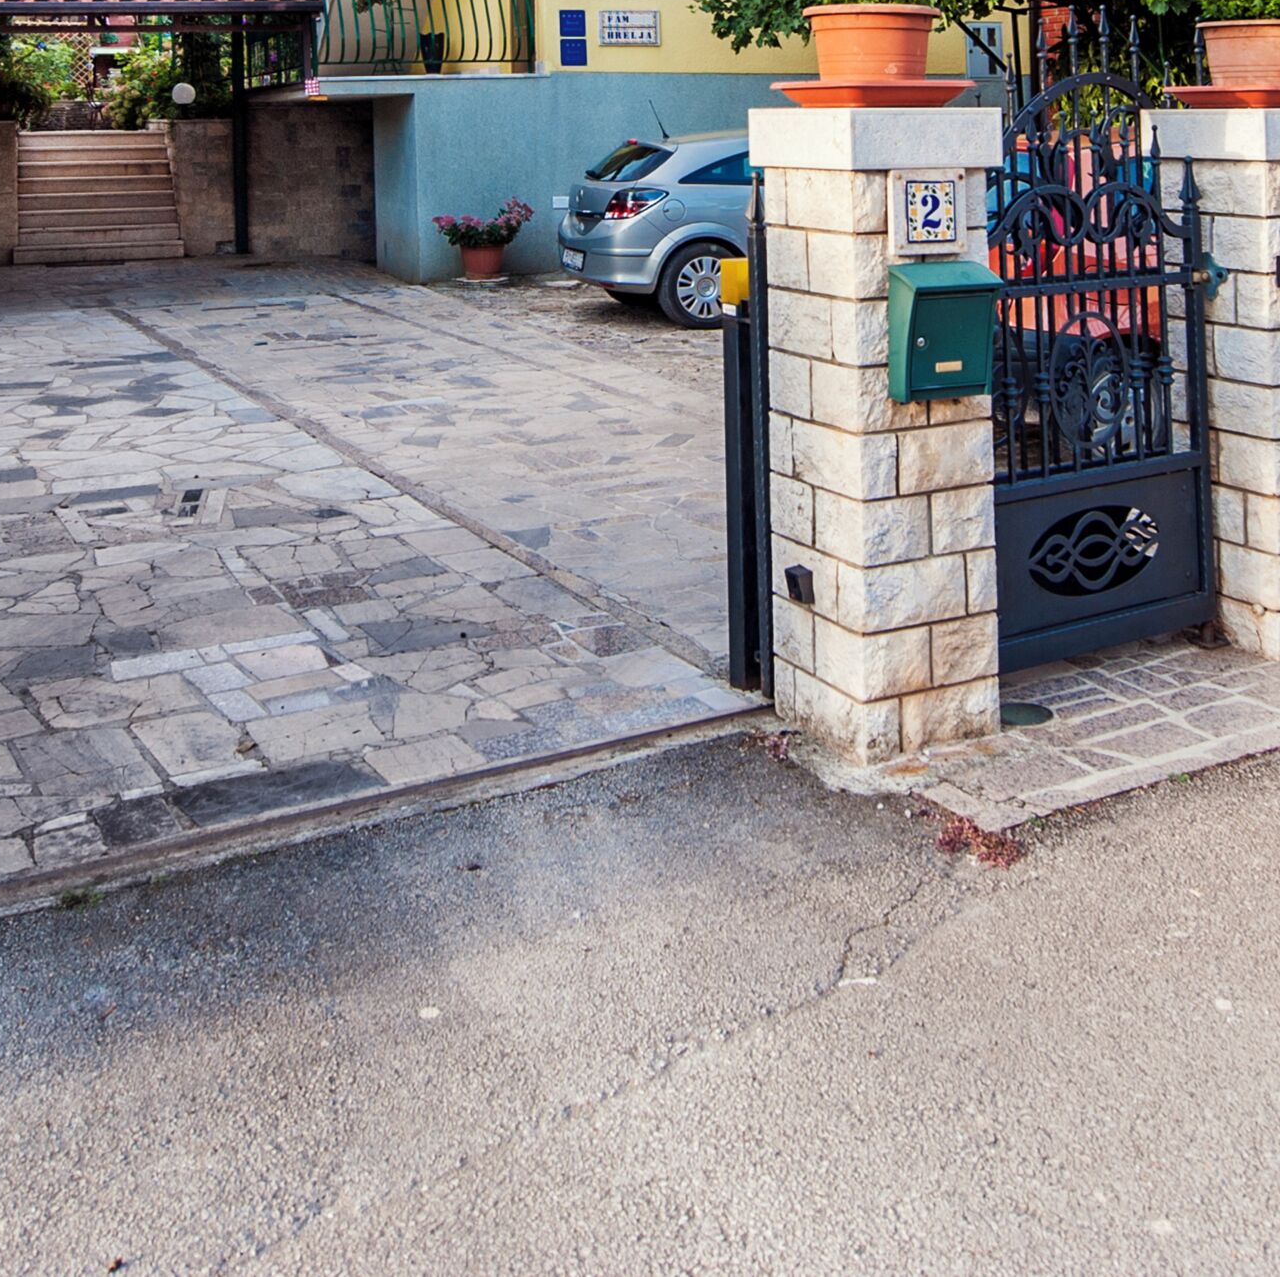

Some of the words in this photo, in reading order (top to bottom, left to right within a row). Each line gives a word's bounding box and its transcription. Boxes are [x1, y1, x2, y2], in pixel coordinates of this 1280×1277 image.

[607, 15, 629, 23] FAM
[607, 31, 652, 39] HRELJA
[921, 194, 942, 229] 2
